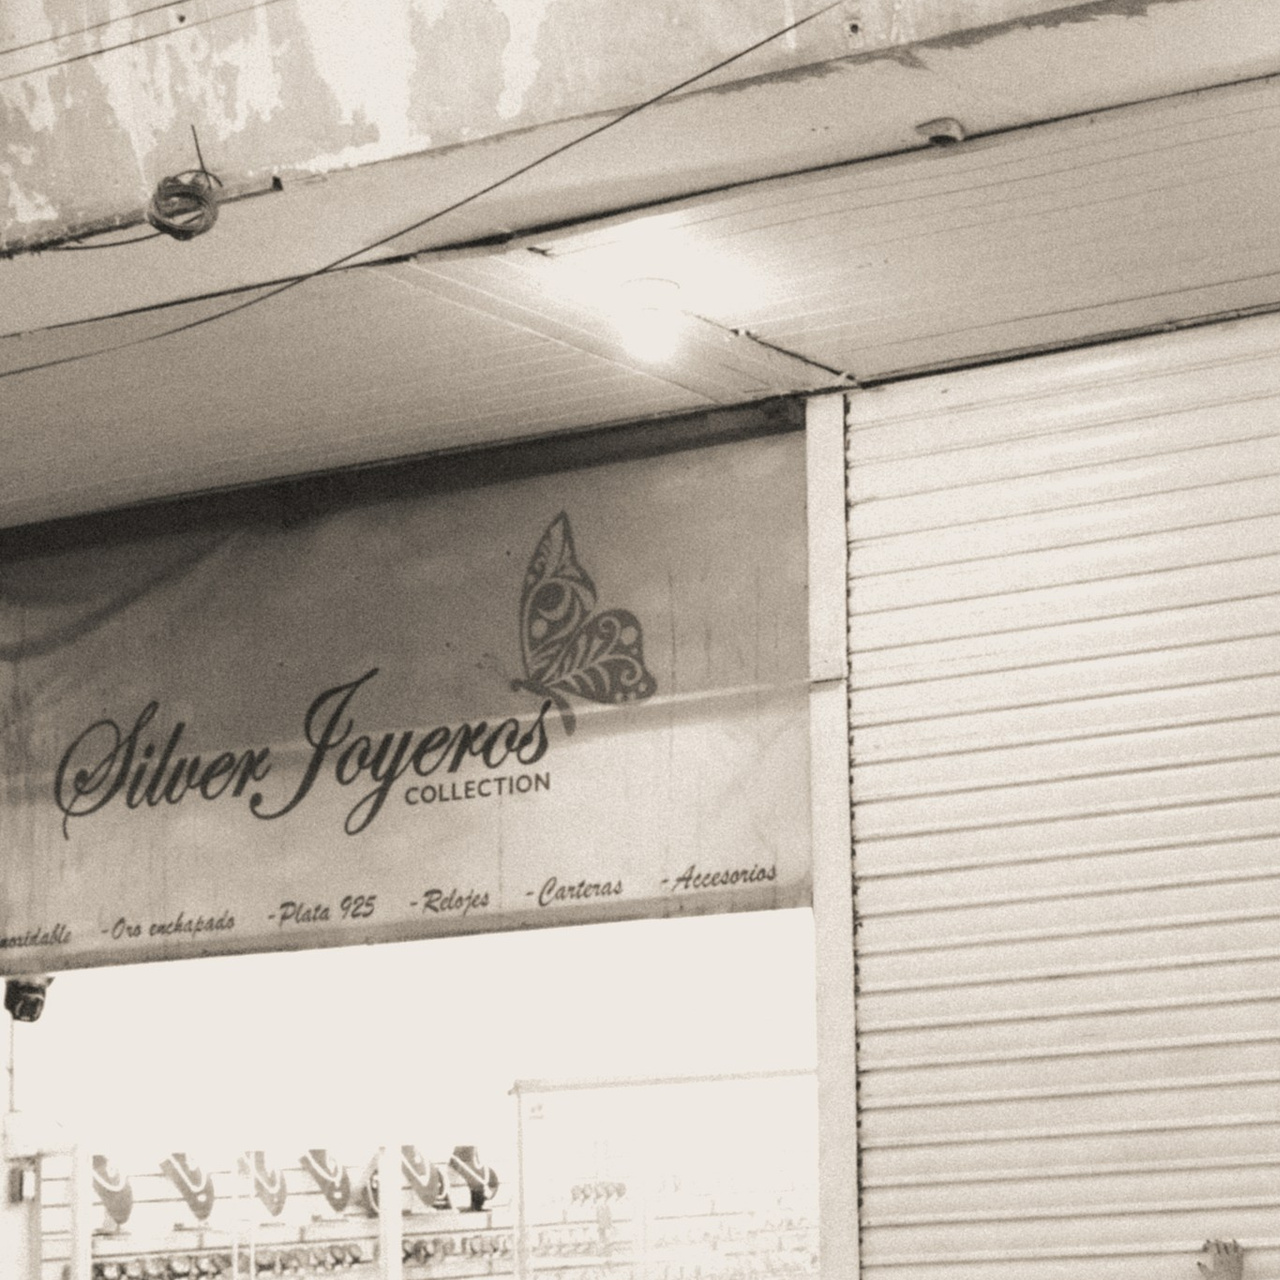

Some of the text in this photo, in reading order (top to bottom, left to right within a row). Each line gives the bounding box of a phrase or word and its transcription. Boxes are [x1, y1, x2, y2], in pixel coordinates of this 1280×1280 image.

[54, 667, 553, 840] Silver Joyeros
[404, 772, 551, 806] COLLECTION
[149, 910, 236, 938] enchapado
[340, 894, 378, 919] 925
